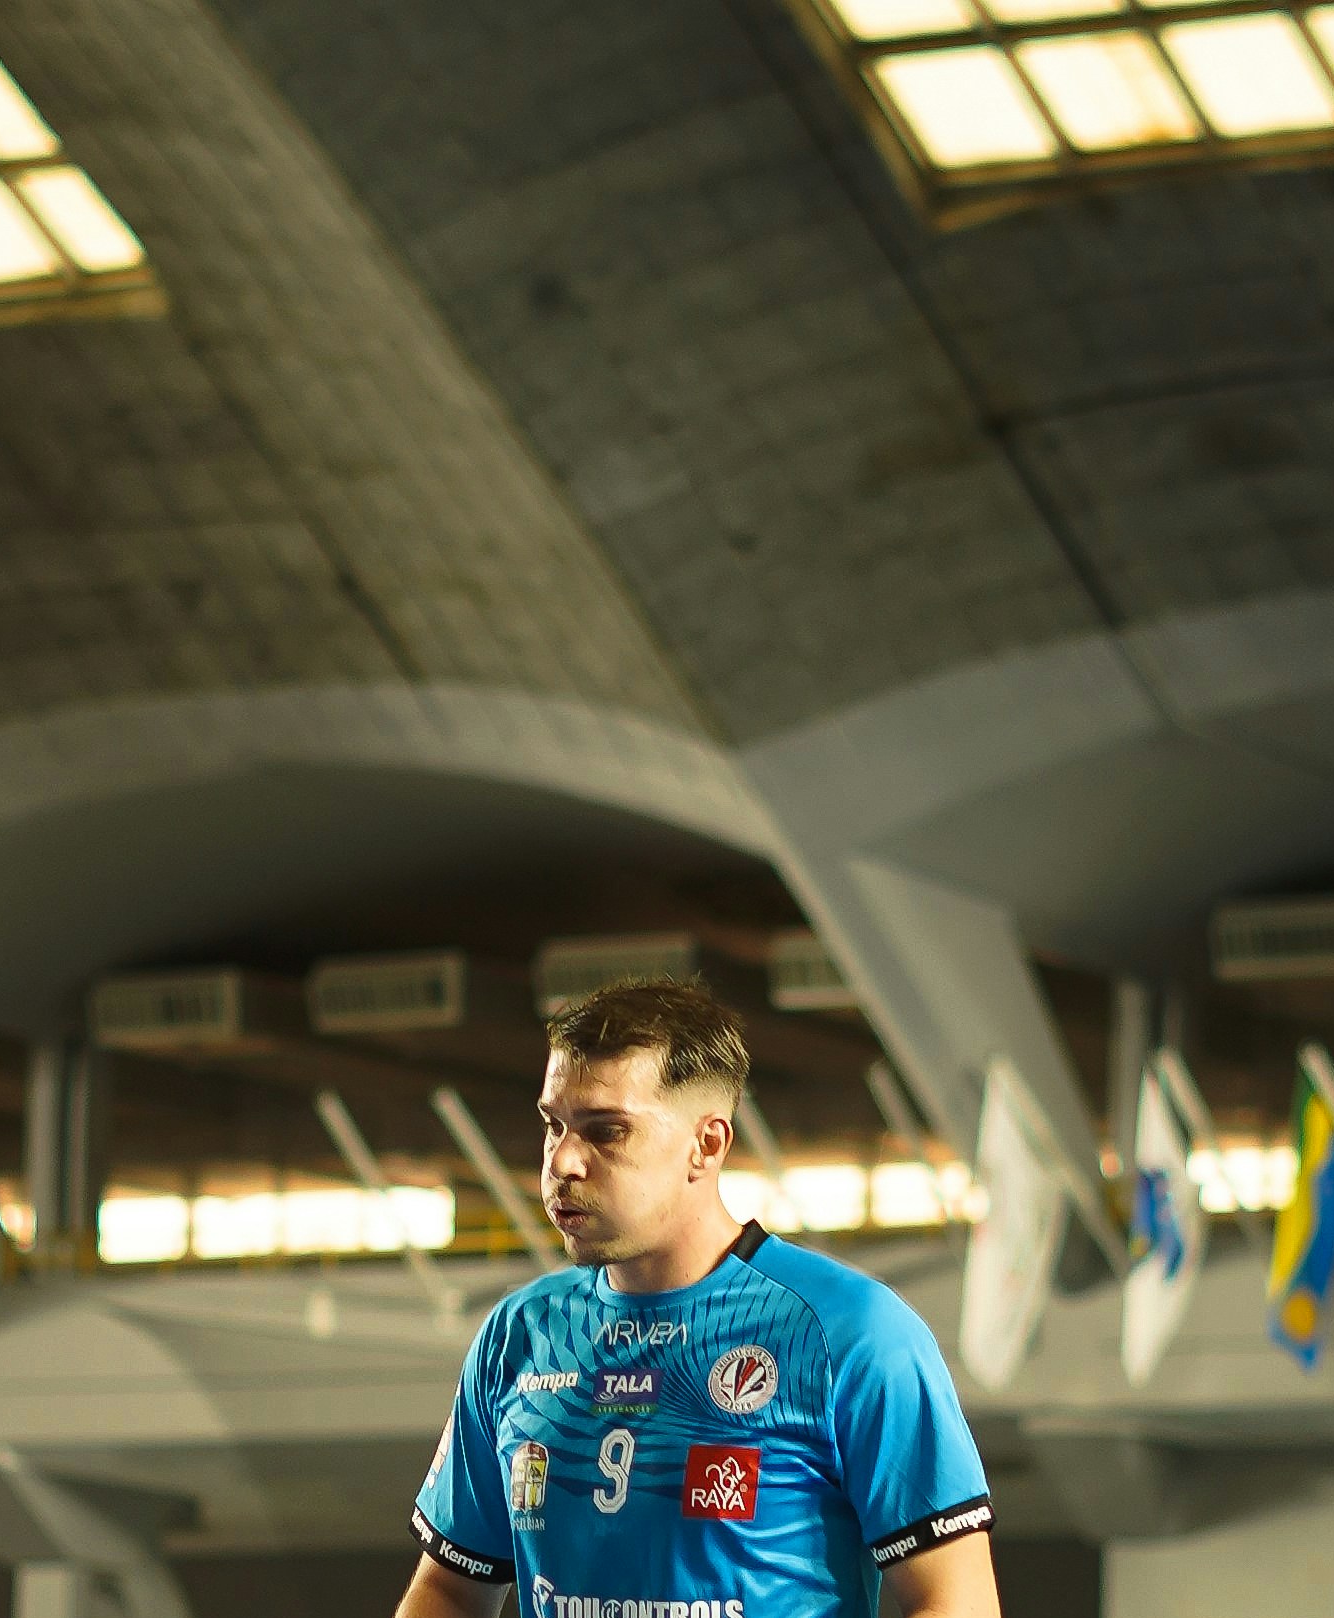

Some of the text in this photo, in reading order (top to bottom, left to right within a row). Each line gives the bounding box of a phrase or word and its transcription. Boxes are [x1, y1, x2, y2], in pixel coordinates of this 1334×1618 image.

[517, 1372, 579, 1395] Kempa
[603, 1374, 653, 1394] TALA
[593, 1428, 636, 1514] 9
[691, 1487, 746, 1511] RAYA
[931, 1505, 992, 1537] Kempa
[439, 1539, 494, 1575] Kempa
[870, 1535, 918, 1563] Kempa
